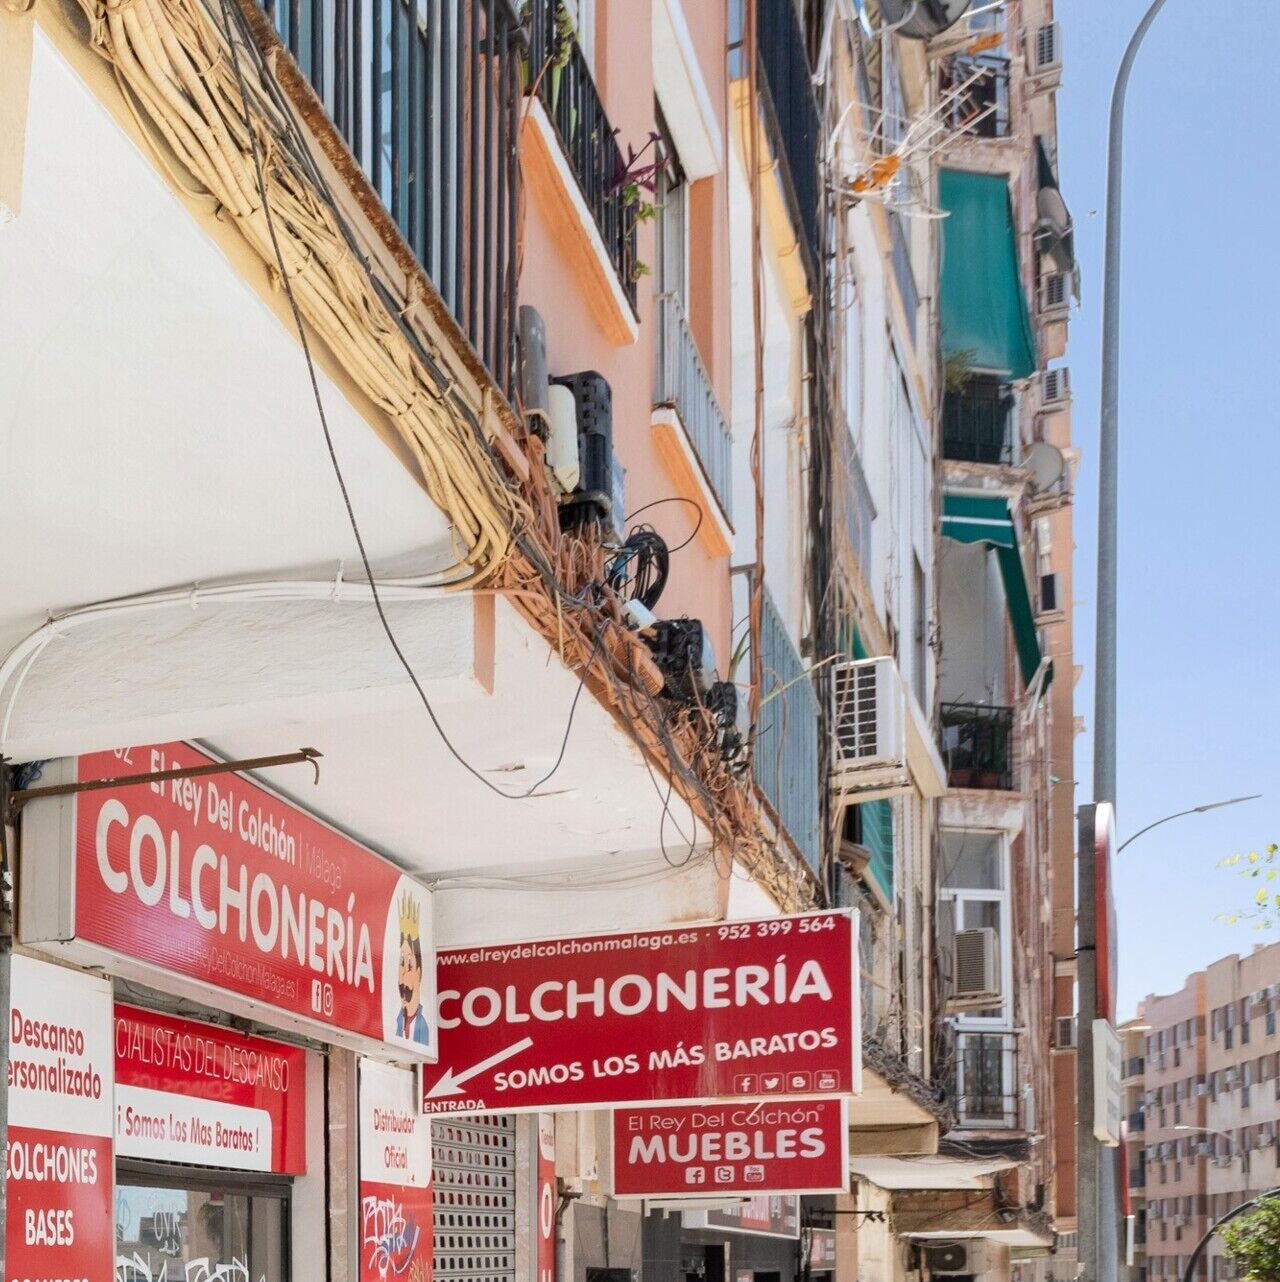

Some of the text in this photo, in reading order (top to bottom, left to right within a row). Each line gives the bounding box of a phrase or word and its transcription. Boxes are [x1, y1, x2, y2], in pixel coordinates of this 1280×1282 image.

[150, 749, 165, 797] El
[171, 761, 202, 827] Rey
[207, 782, 233, 833] Del
[239, 800, 296, 866] Colchón
[95, 798, 375, 994] COLCHONERÍA
[437, 916, 836, 966] ww.elreydelcolchonmalaga.es 952 399 564
[437, 954, 832, 1030] COLCHONERÍA
[11, 1008, 84, 1057] Descanso
[8, 1057, 102, 1100] ersonalizado
[195, 1037, 221, 1079] DEL
[223, 1045, 289, 1093] DESCANSO
[493, 1027, 838, 1092] SOMOS LOS MÁS BARATOS
[125, 1106, 165, 1140] Somos
[169, 1113, 187, 1143] Los
[190, 1117, 212, 1148] Mas
[215, 1120, 253, 1152] Baratos
[423, 1099, 486, 1113] ENTRADA
[628, 1107, 819, 1133] El Rey Del Colchón
[628, 1127, 826, 1165] MUEBLES
[25, 1208, 74, 1247] BASES
